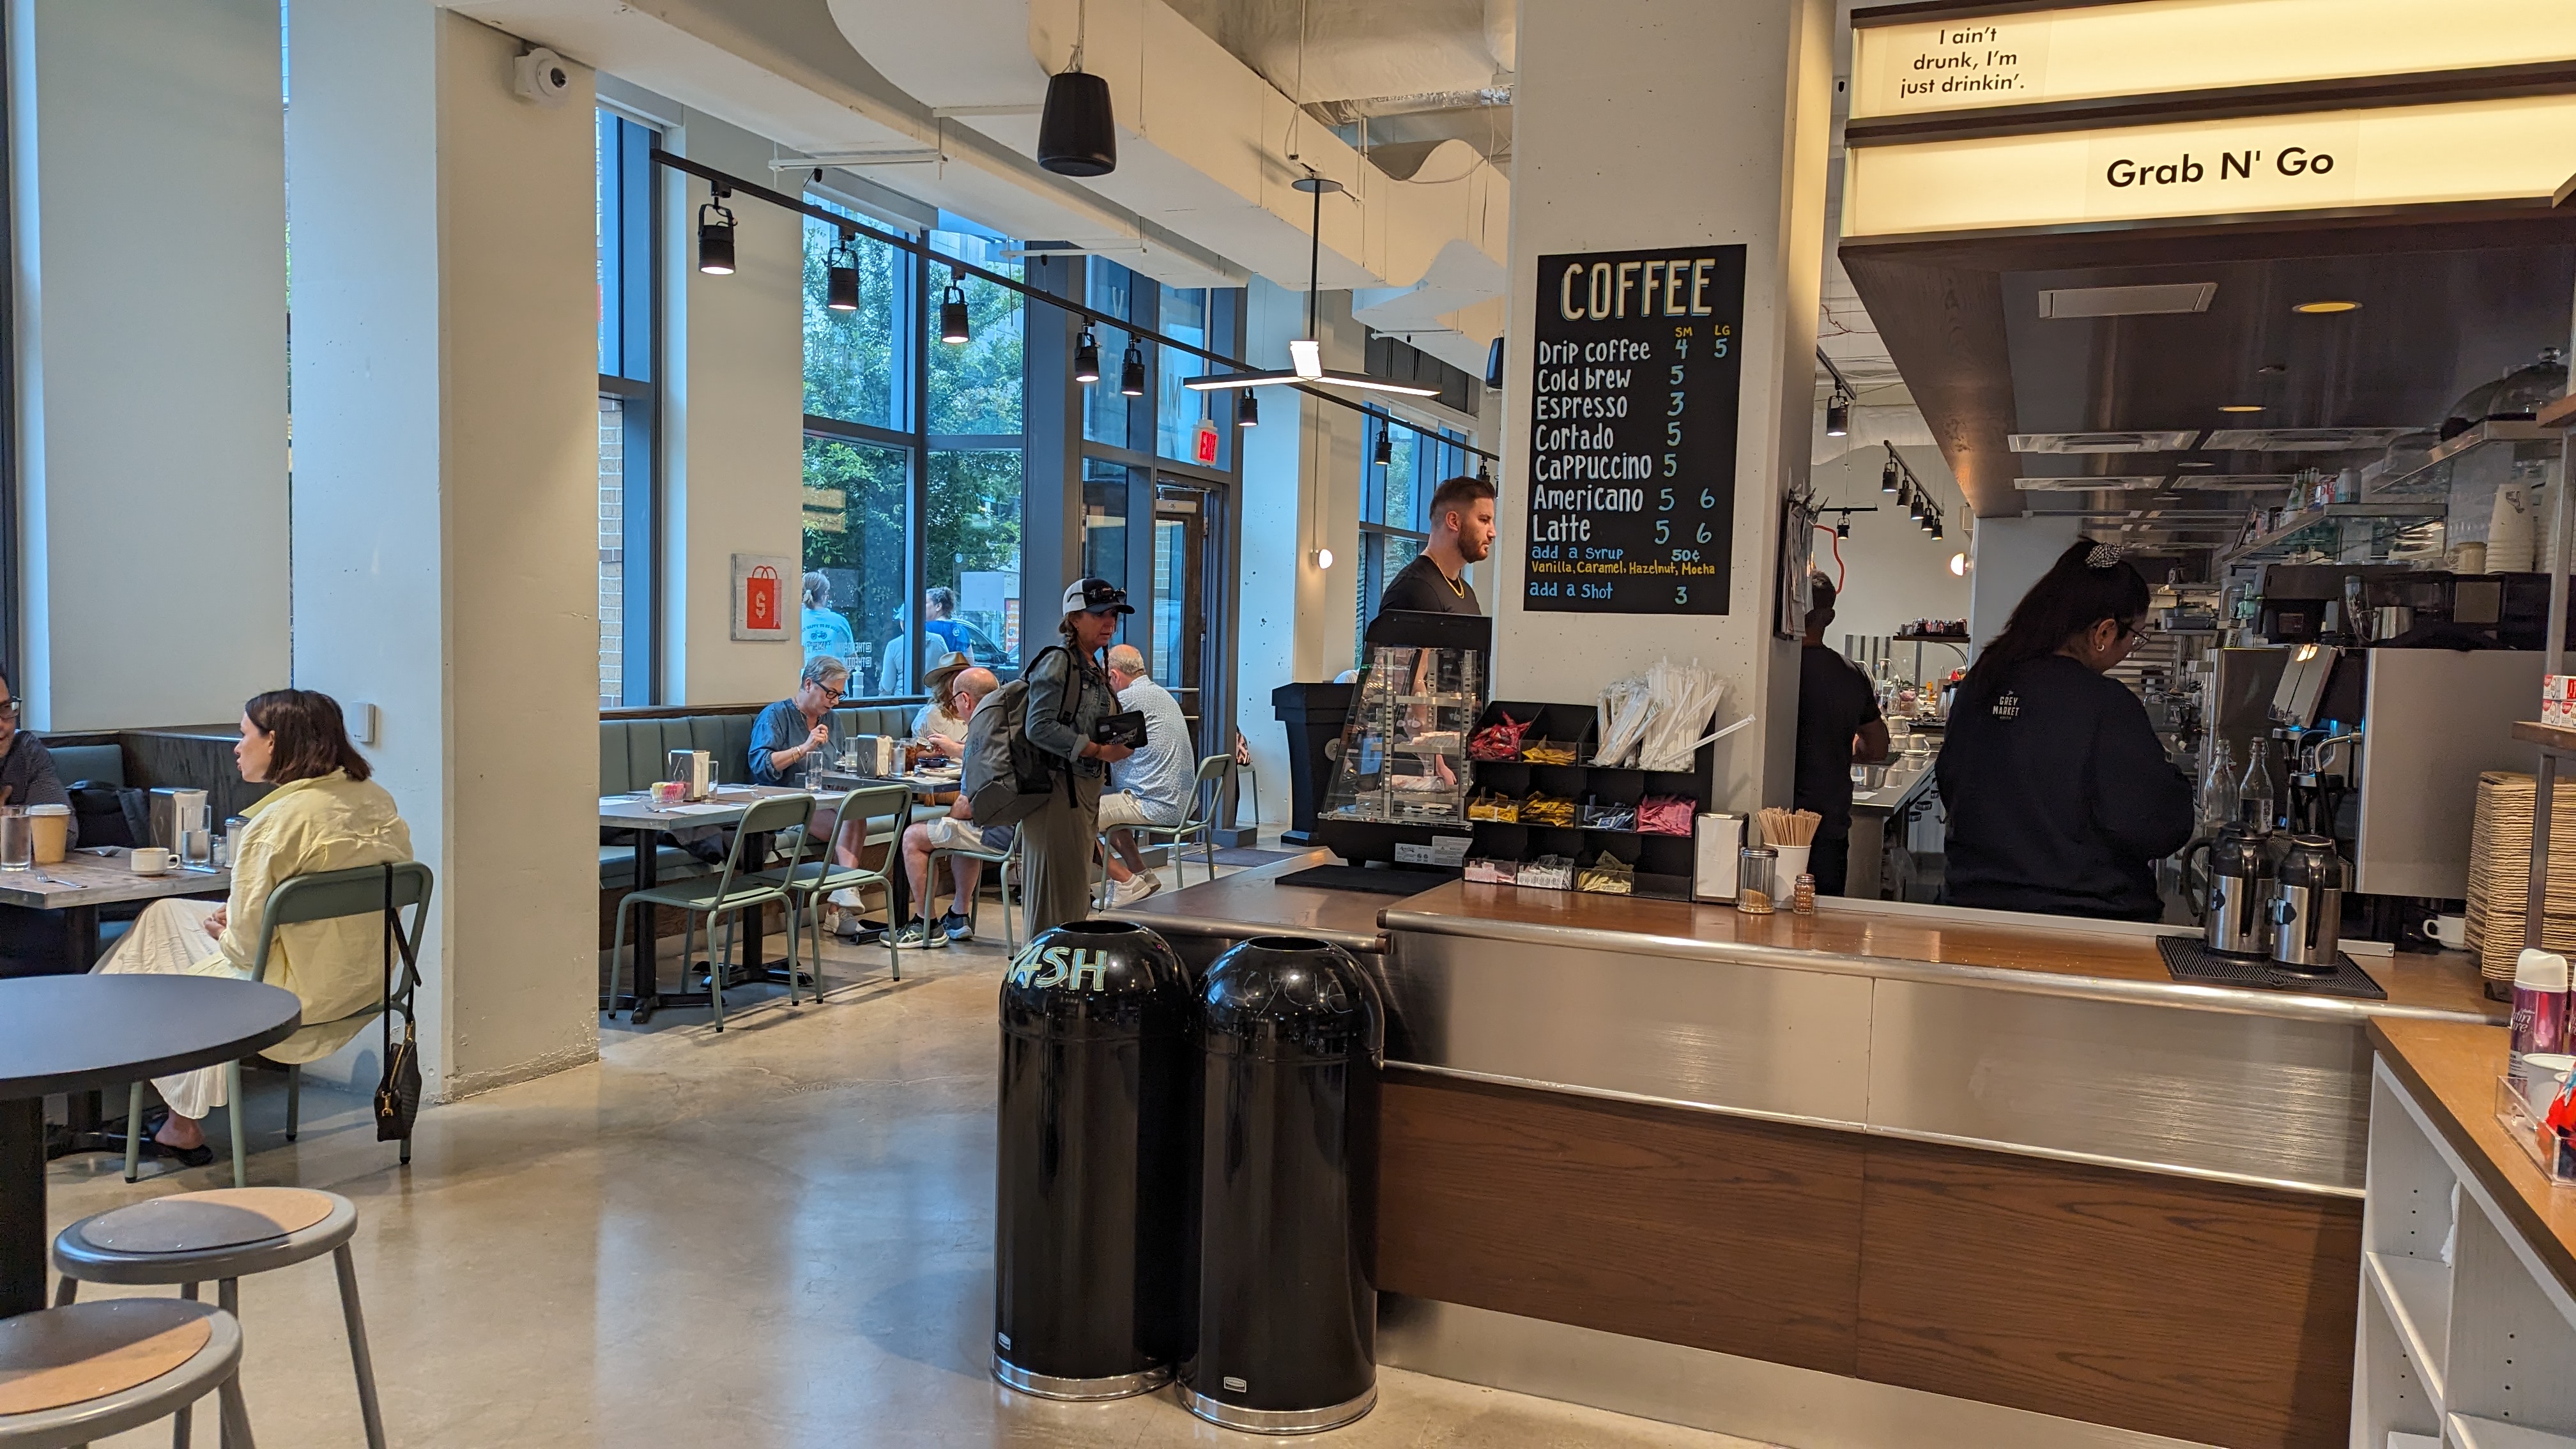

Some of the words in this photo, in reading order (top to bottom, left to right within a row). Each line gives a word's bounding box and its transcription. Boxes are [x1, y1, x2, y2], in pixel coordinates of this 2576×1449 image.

[1940, 29, 1945, 44] I
[1952, 27, 1997, 44] ain't
[1914, 52, 1978, 70] drunk,
[1988, 50, 2016, 66] I'm
[1901, 79, 1935, 98] just
[1942, 74, 2023, 92] drinkin'.
[2107, 154, 2204, 187] Grab
[2221, 151, 2260, 180] N'
[2277, 147, 2333, 176] Go
[1561, 259, 1715, 321] COFFEE
[1676, 327, 1692, 337] SM
[1715, 325, 1729, 335] LG
[1540, 341, 1578, 364] Drip
[1586, 339, 1650, 362] coffee
[1676, 339, 1687, 358] 4
[1714, 338, 1727, 357] 5
[1538, 369, 1578, 392] Cold
[1586, 367, 1631, 390] brew
[1670, 365, 1683, 385] 5
[1537, 396, 1627, 420] Espresso
[1667, 392, 1684, 416] 3
[1536, 424, 1613, 451] Cortado
[1667, 422, 1680, 446] 5
[1664, 454, 1676, 477] 5
[1534, 484, 1643, 512] Americano
[1659, 489, 1674, 510] 5
[1701, 489, 1715, 508] 6
[1533, 514, 1590, 542] Latte
[1655, 520, 1669, 544] 5
[1697, 523, 1711, 543] 6
[1532, 546, 1558, 558] add
[1569, 548, 1578, 558] a
[1532, 561, 1575, 573] Vanilla,
[1577, 561, 1626, 573] Caramel,
[1629, 561, 1678, 576] Hazelnut,
[1682, 562, 1715, 575] Mocha
[1530, 582, 1557, 596] add
[1567, 584, 1575, 596] a
[1675, 586, 1687, 604] 3
[1993, 705, 2020, 716] MARKET
[1999, 696, 2018, 706] GREY
